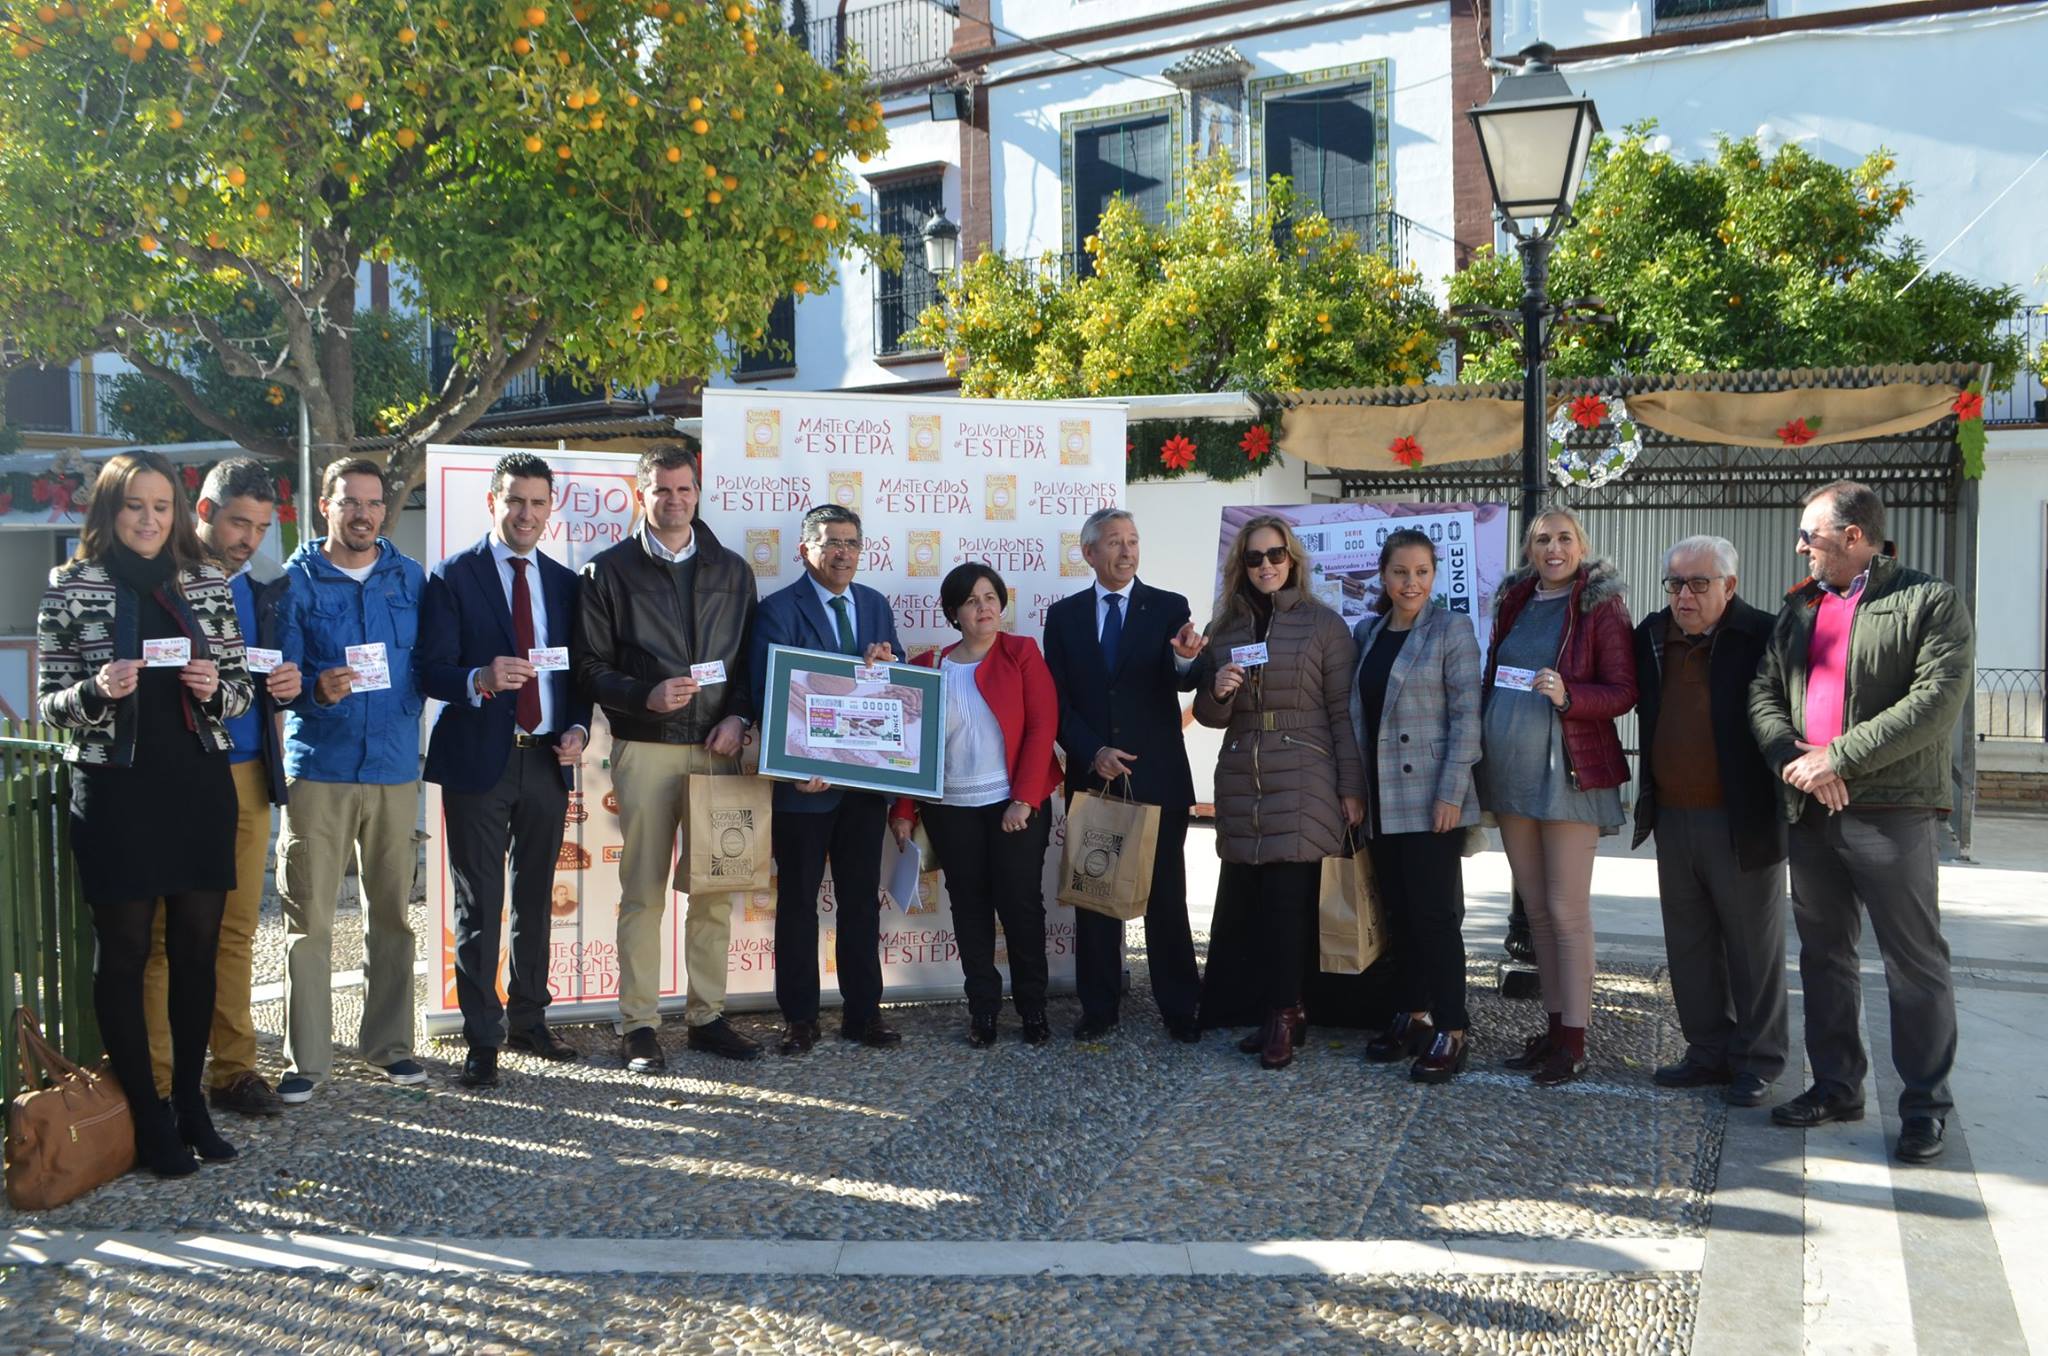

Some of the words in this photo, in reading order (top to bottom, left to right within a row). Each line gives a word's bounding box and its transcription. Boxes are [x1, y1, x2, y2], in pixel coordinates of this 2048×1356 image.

[959, 422, 1045, 439] POLVORONES
[806, 434, 894, 455] ESTEPA
[965, 438, 1046, 459] ESTEPA
[716, 475, 811, 492] POLVORONES
[1034, 481, 1117, 497] POLVORONES
[723, 491, 813, 512] ESTEPA
[887, 493, 972, 514] ESTEPA
[959, 537, 1044, 551] POLVORONES
[1344, 540, 1364, 550] 000
[1452, 548, 1465, 593] ONCE
[879, 930, 956, 945] MANTECADO
